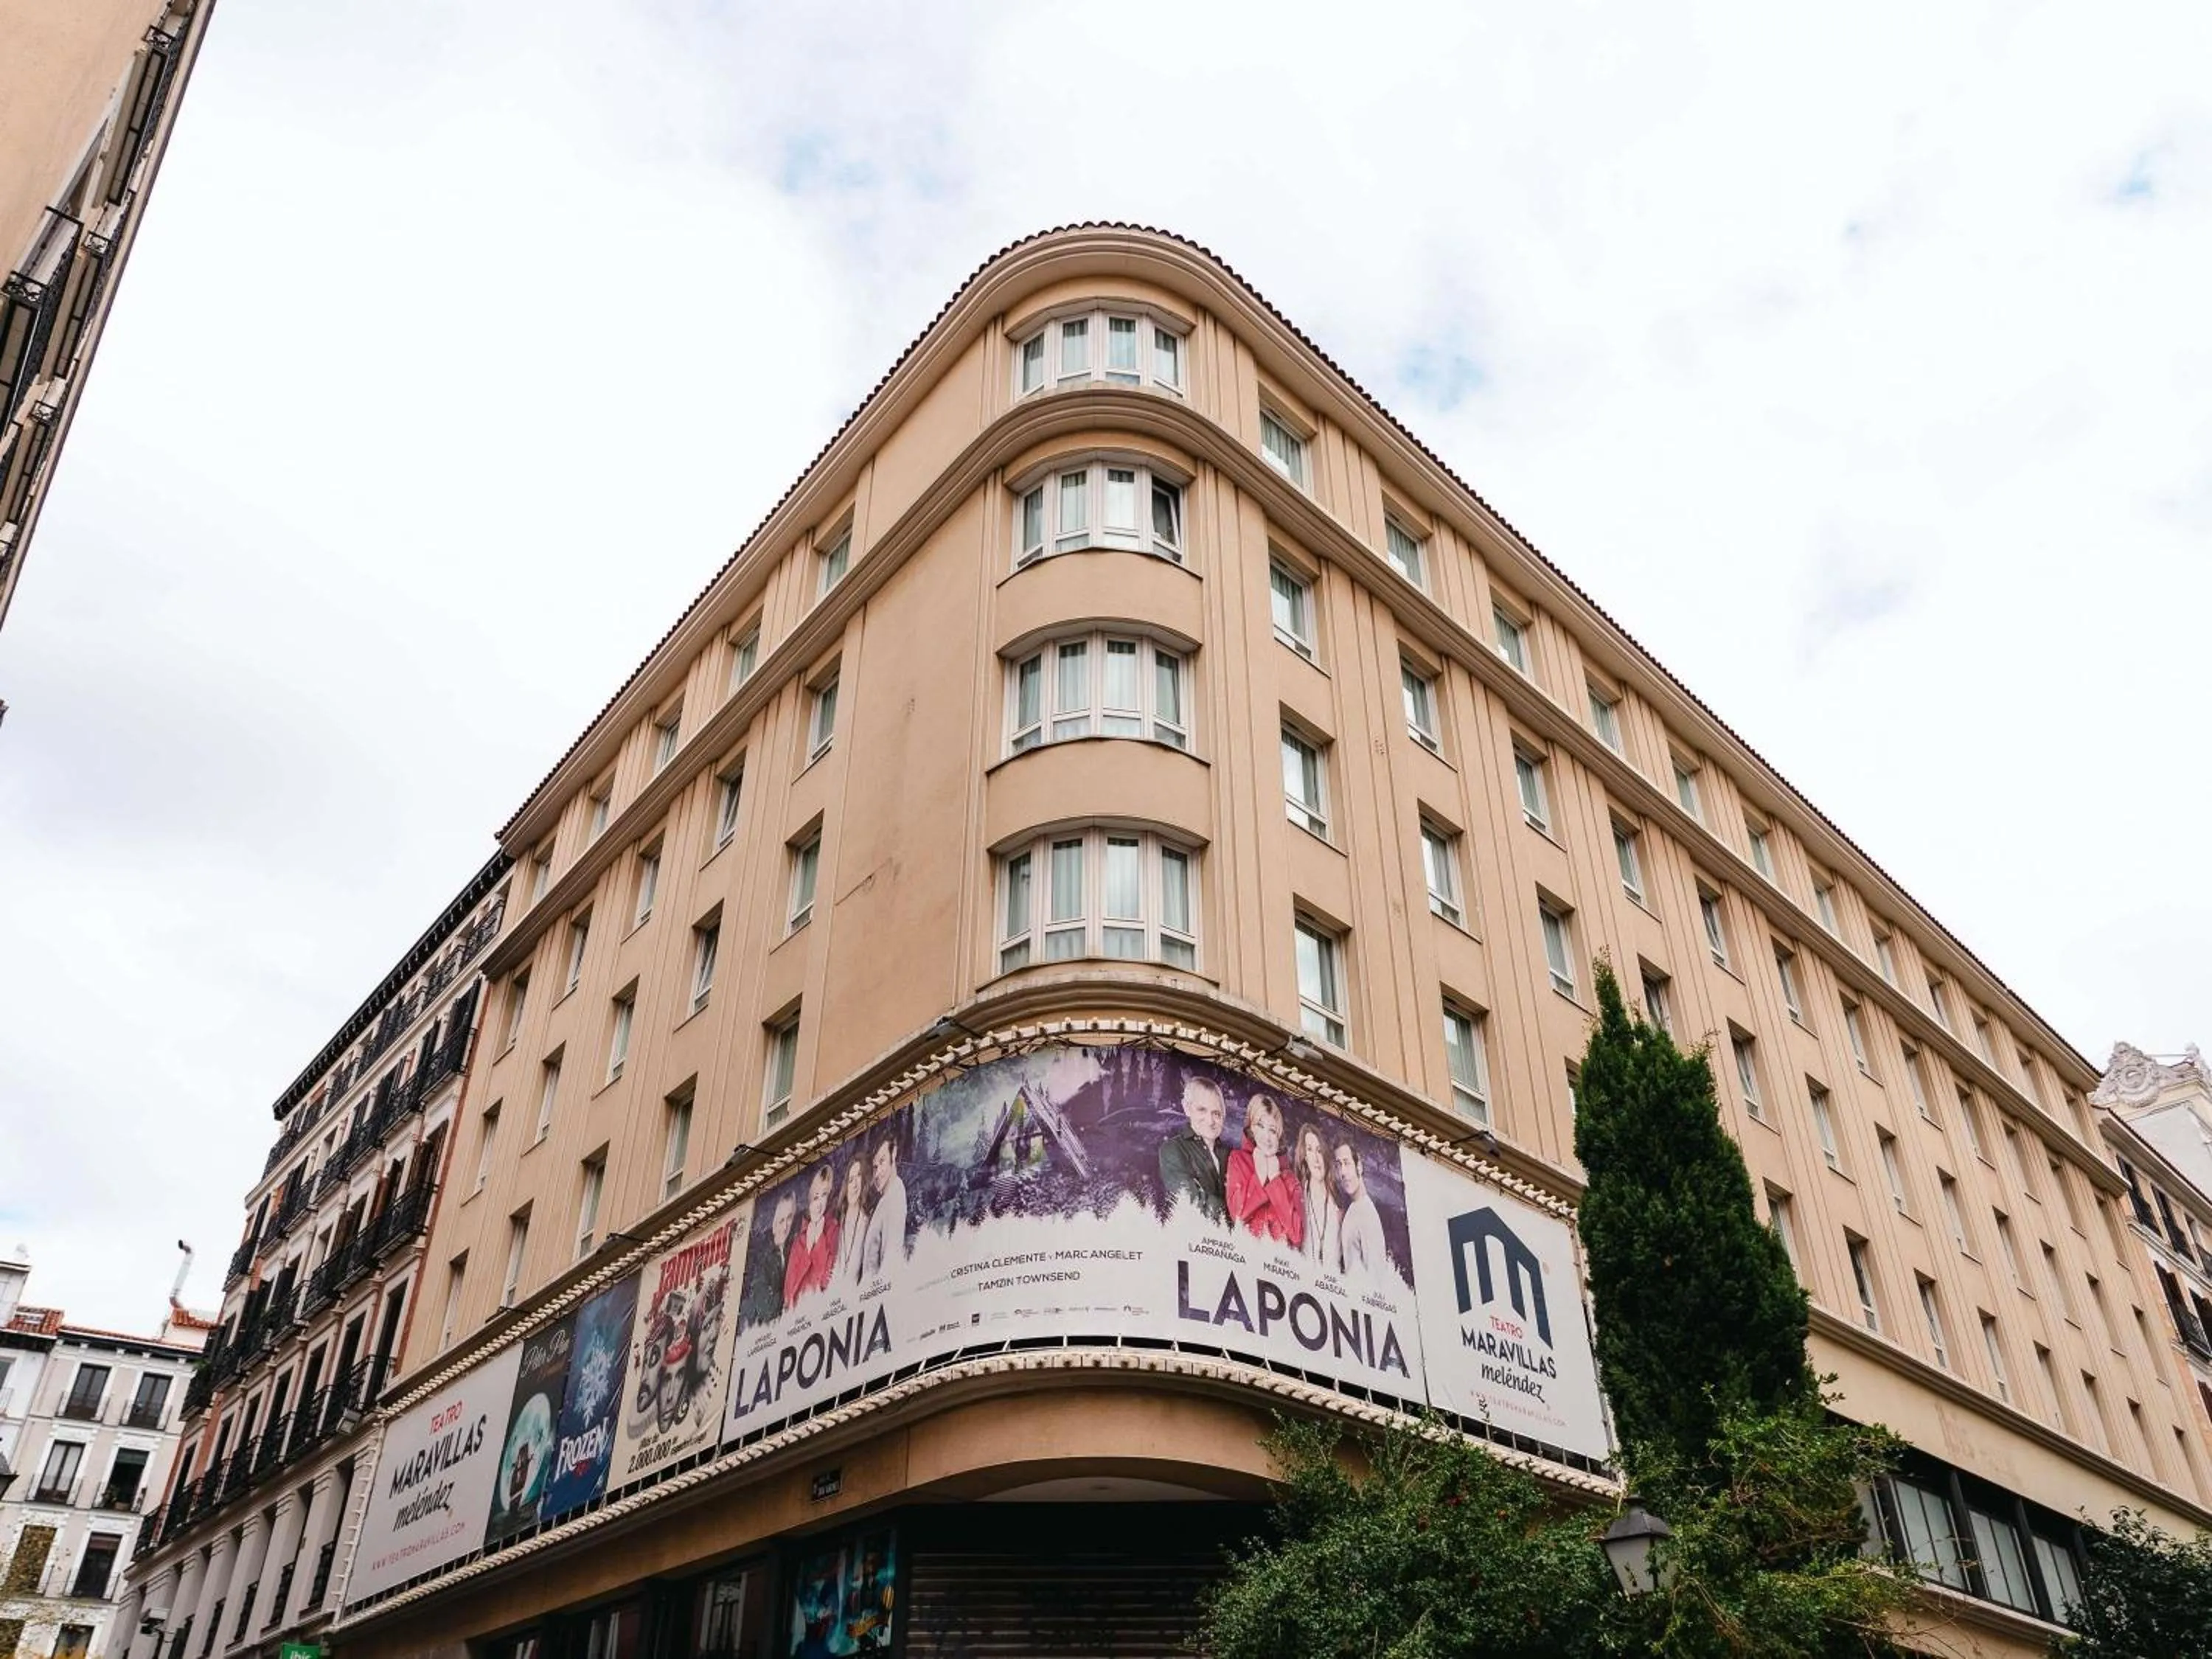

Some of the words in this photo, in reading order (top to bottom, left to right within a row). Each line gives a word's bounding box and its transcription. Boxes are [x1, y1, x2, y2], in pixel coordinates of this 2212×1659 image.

[950, 1261, 990, 1279] CRISTINA
[992, 1253, 1046, 1267] CLEMENTE
[1055, 1251, 1088, 1260] MARC
[1090, 1250, 1143, 1260] ANGELET
[978, 1278, 1014, 1292] TAMZIN
[1016, 1271, 1080, 1284] TOWNSEND
[1178, 1259, 1411, 1379] LAPONIA
[1490, 1315, 1523, 1339] TEATRO
[734, 1303, 892, 1419] LAPONIA
[1461, 1325, 1557, 1380] MARAVILLAS
[1481, 1363, 1545, 1403] meléndez
[430, 1400, 462, 1435] TEATRO
[389, 1413, 487, 1499] MARAVILLAS
[554, 1416, 610, 1483] FROZEN
[392, 1480, 455, 1532] meléndez
